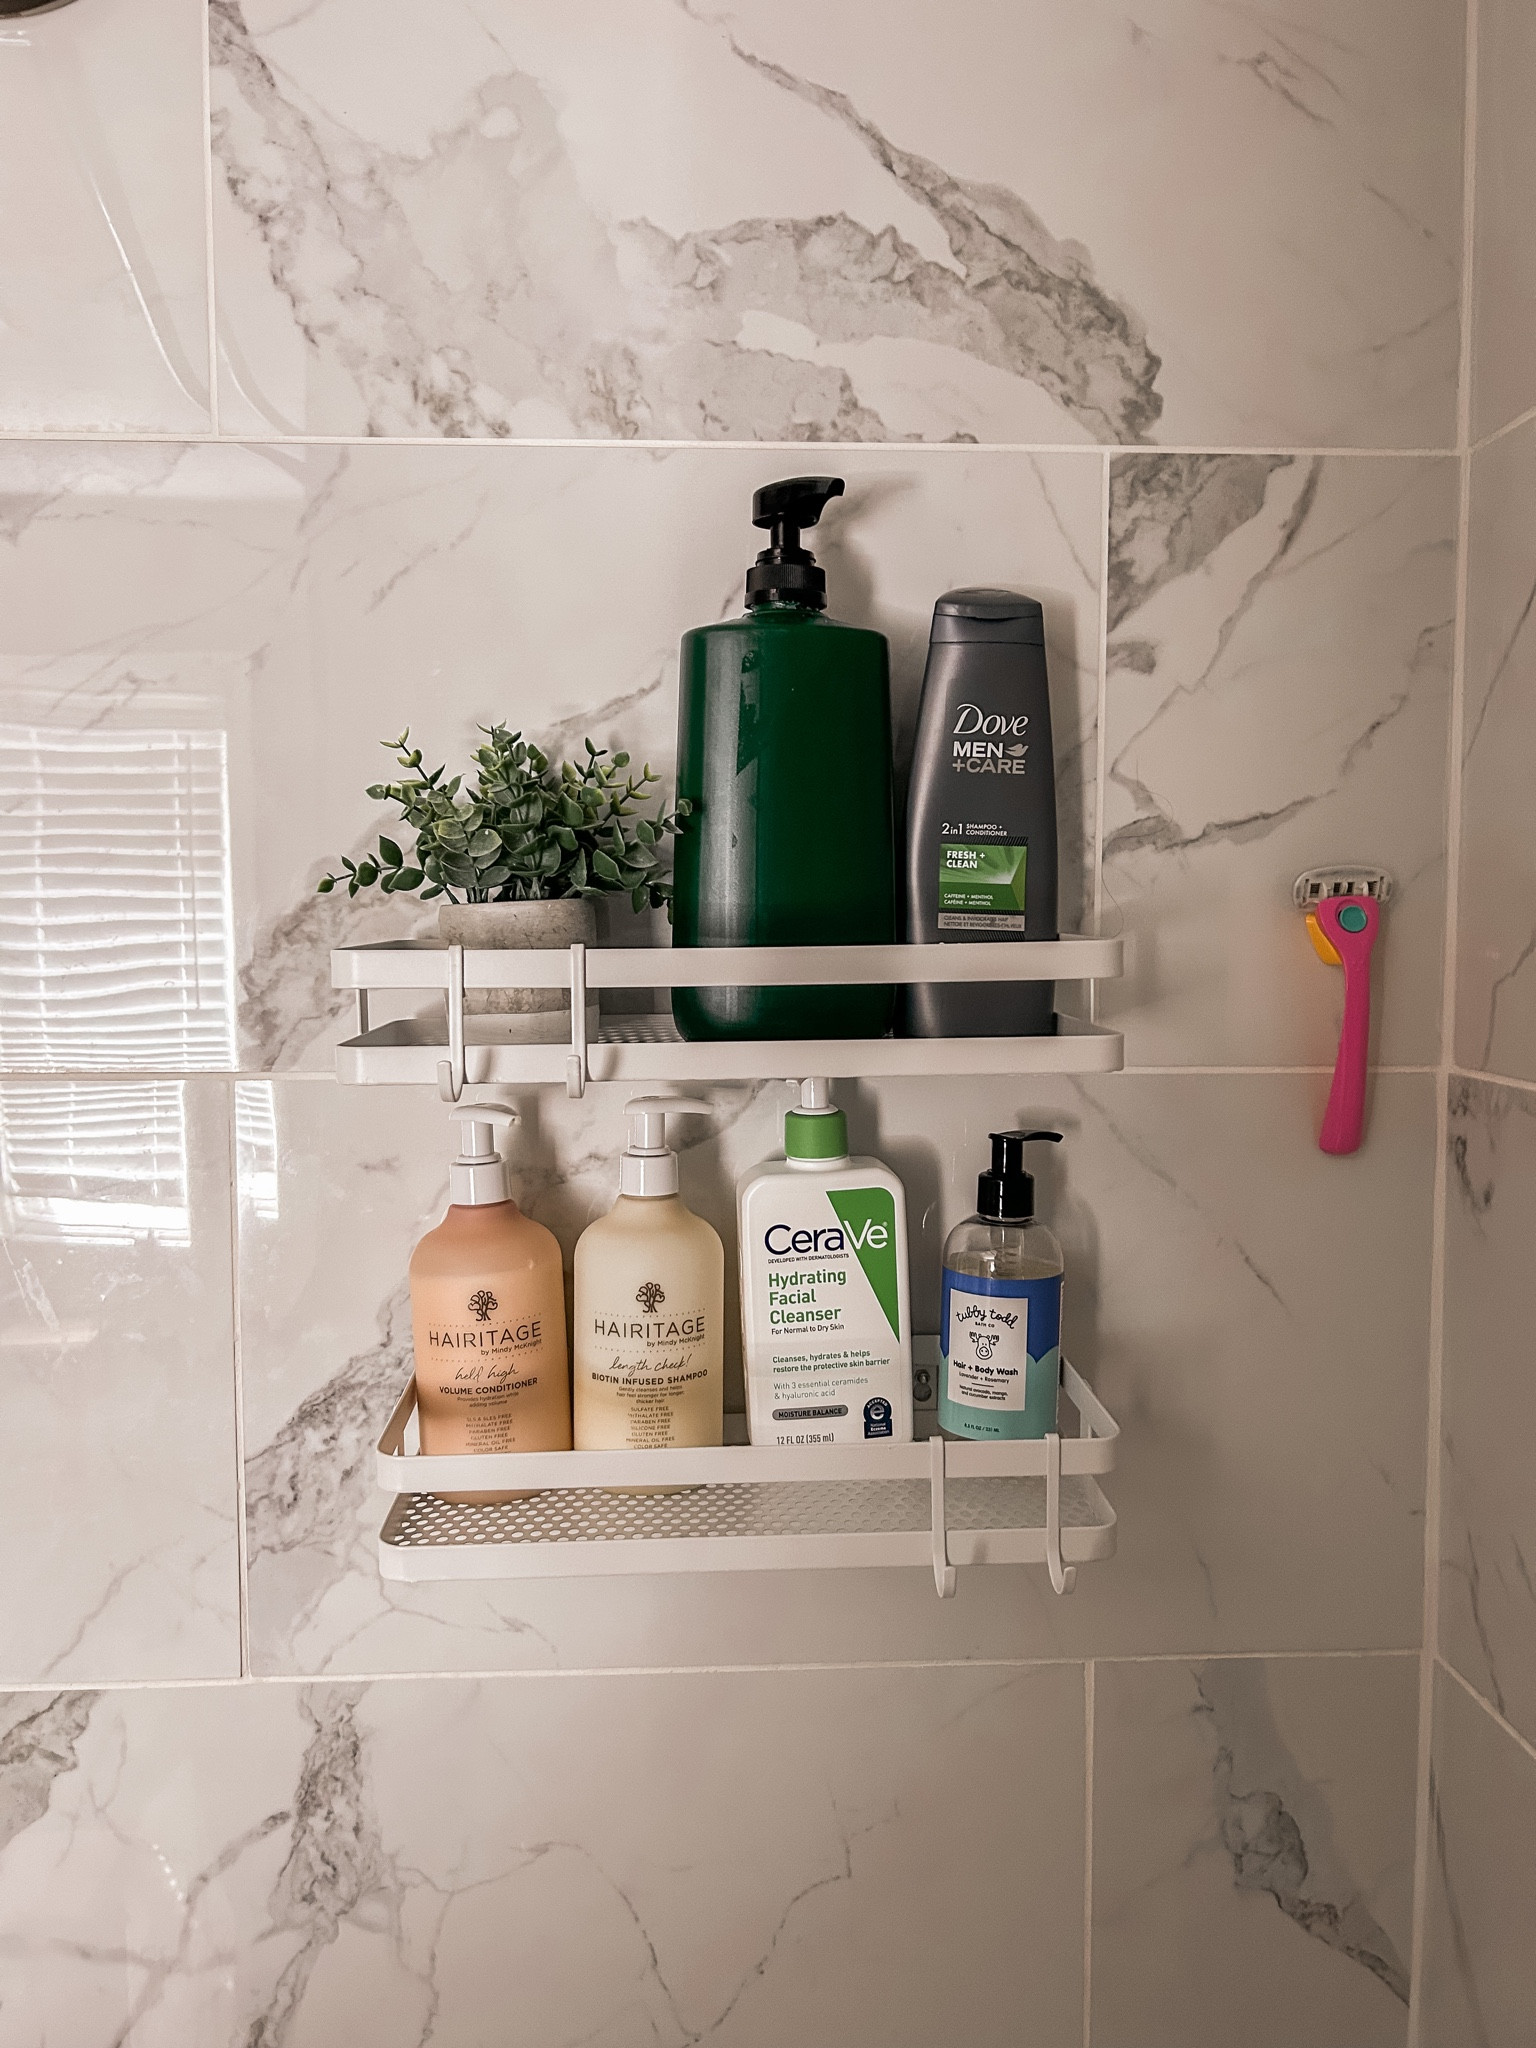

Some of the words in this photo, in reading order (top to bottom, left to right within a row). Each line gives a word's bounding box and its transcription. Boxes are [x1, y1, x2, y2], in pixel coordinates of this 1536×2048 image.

[953, 703, 1029, 736] Dove
[953, 741, 1003, 758] MEN
[952, 759, 1026, 775] +CARE
[947, 851, 977, 859] FRESH
[946, 860, 977, 869] CLEAN
[764, 1218, 888, 1255] CeraVe
[768, 1269, 846, 1289] Hydrating
[769, 1289, 816, 1306] Facial
[770, 1308, 841, 1325] Cleanser
[956, 1305, 987, 1322] tubby
[989, 1309, 1019, 1330] todd
[429, 1321, 541, 1348] HAIRITAGE
[594, 1316, 705, 1339] HAIRITAGE
[784, 1325, 809, 1334] Normal
[491, 1344, 512, 1354] Mindy
[514, 1338, 542, 1350] McKnight
[657, 1338, 677, 1347] Mindy
[679, 1333, 705, 1344] McKnight
[772, 1355, 808, 1363] Cleanses,
[809, 1353, 841, 1362] hydrates
[850, 1350, 870, 1359] helps
[488, 1363, 519, 1384] high
[609, 1356, 652, 1377] length
[773, 1365, 799, 1373] restore
[800, 1363, 812, 1371] the
[813, 1361, 848, 1372] protective
[849, 1359, 864, 1367] skin
[865, 1358, 890, 1366] barrier
[953, 1360, 966, 1369] Hair
[975, 1365, 994, 1376] Body
[996, 1368, 1019, 1376] Wash
[592, 1372, 619, 1384] BIOTIN
[622, 1377, 664, 1386] INFUSED
[667, 1369, 708, 1384] SHAMPOO
[774, 1382, 790, 1390] With
[798, 1380, 830, 1389] essential
[831, 1377, 868, 1386] ceramides
[985, 1376, 1010, 1384] Rosemary
[439, 1386, 473, 1395] VOLUME
[476, 1377, 538, 1395] CONDITIONER
[782, 1390, 819, 1400] hyaluronic
[821, 1389, 836, 1397] acid
[779, 1410, 811, 1418] MOISTURE
[813, 1408, 842, 1416] BALANCE
[776, 1437, 785, 1445] 12
[787, 1436, 794, 1444] FL
[796, 1435, 805, 1444] OZ
[806, 1434, 821, 1444] (355
[823, 1433, 835, 1443] ml)
